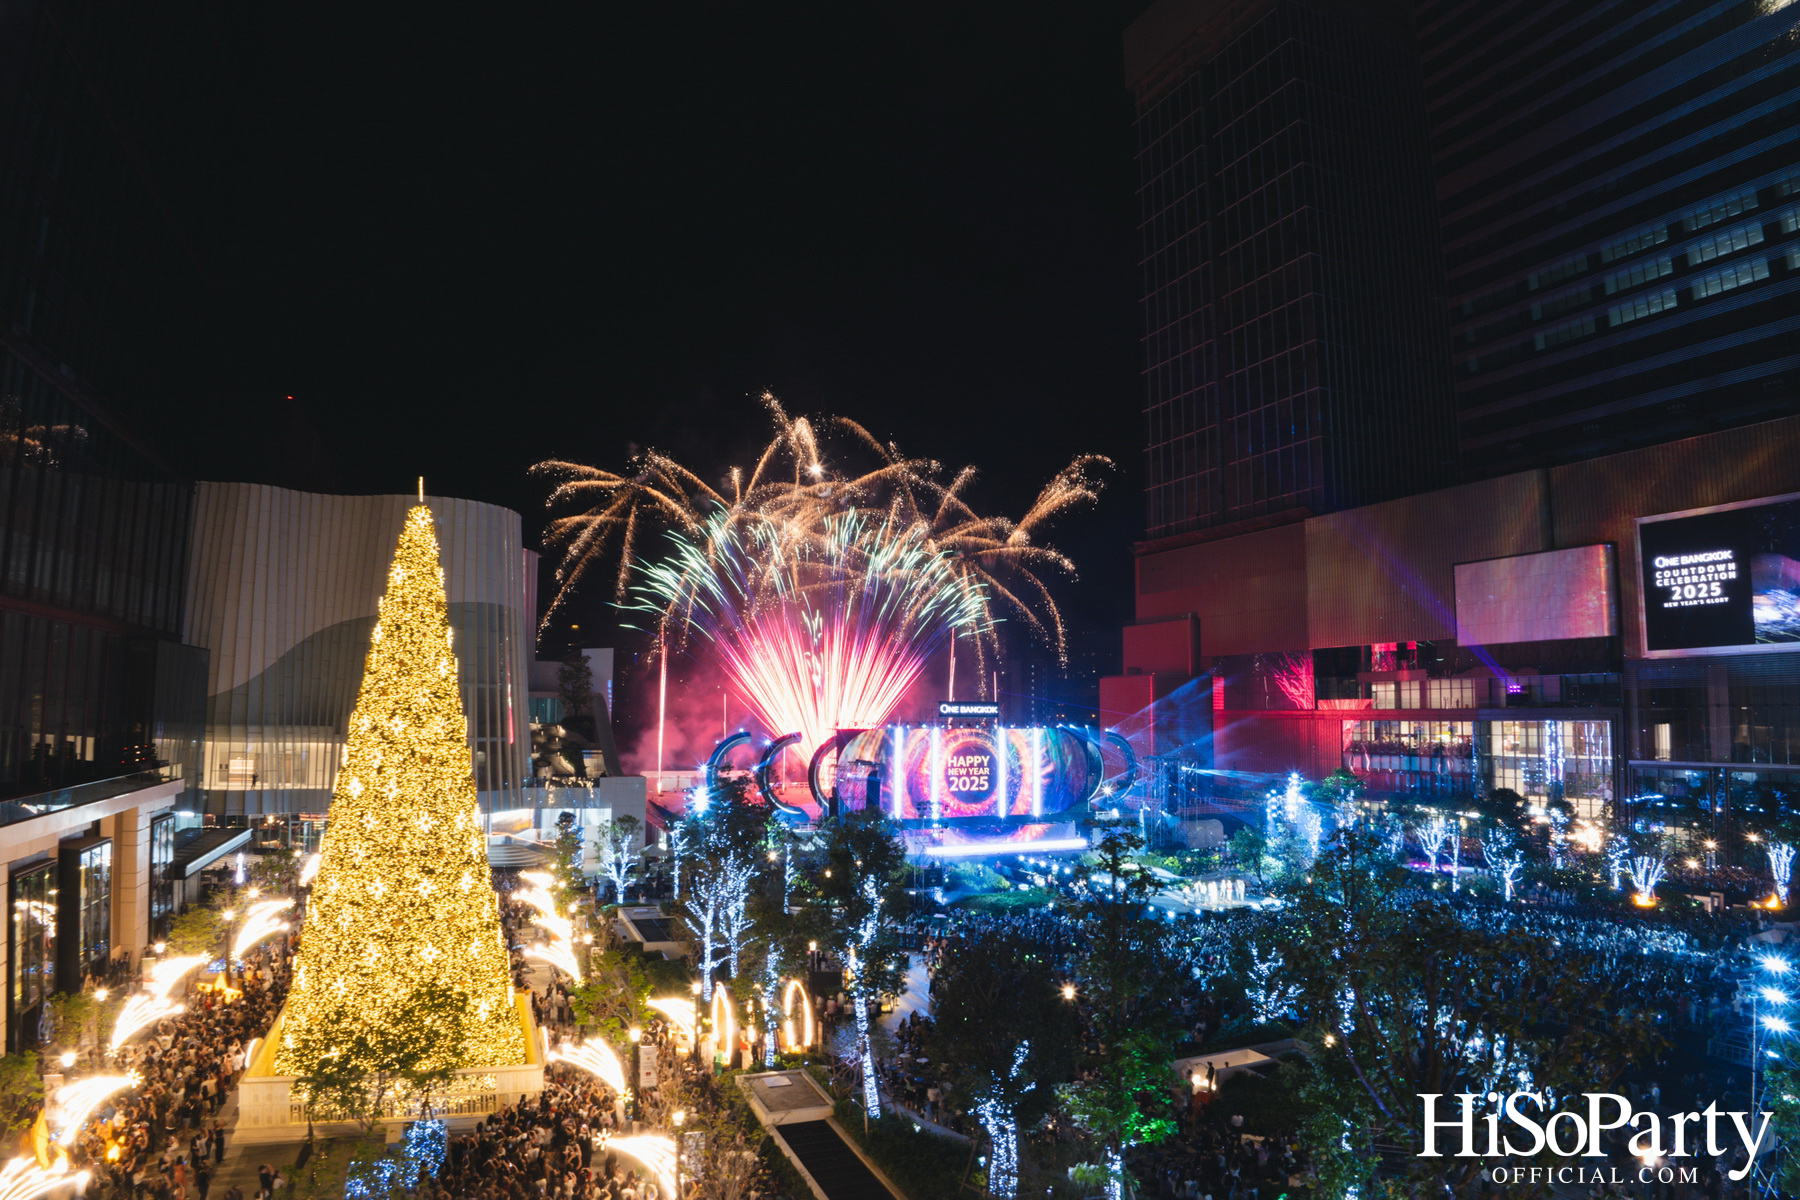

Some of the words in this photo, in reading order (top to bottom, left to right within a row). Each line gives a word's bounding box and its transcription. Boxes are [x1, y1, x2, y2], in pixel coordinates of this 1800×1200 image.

[1680, 550, 1733, 565] BANGKOK
[1655, 562, 1737, 579] COUNTDOWN
[1655, 571, 1737, 587] CELEBRATION
[1671, 582, 1722, 600] 2025
[948, 756, 990, 767] HAPPY
[949, 776, 989, 791] 2025
